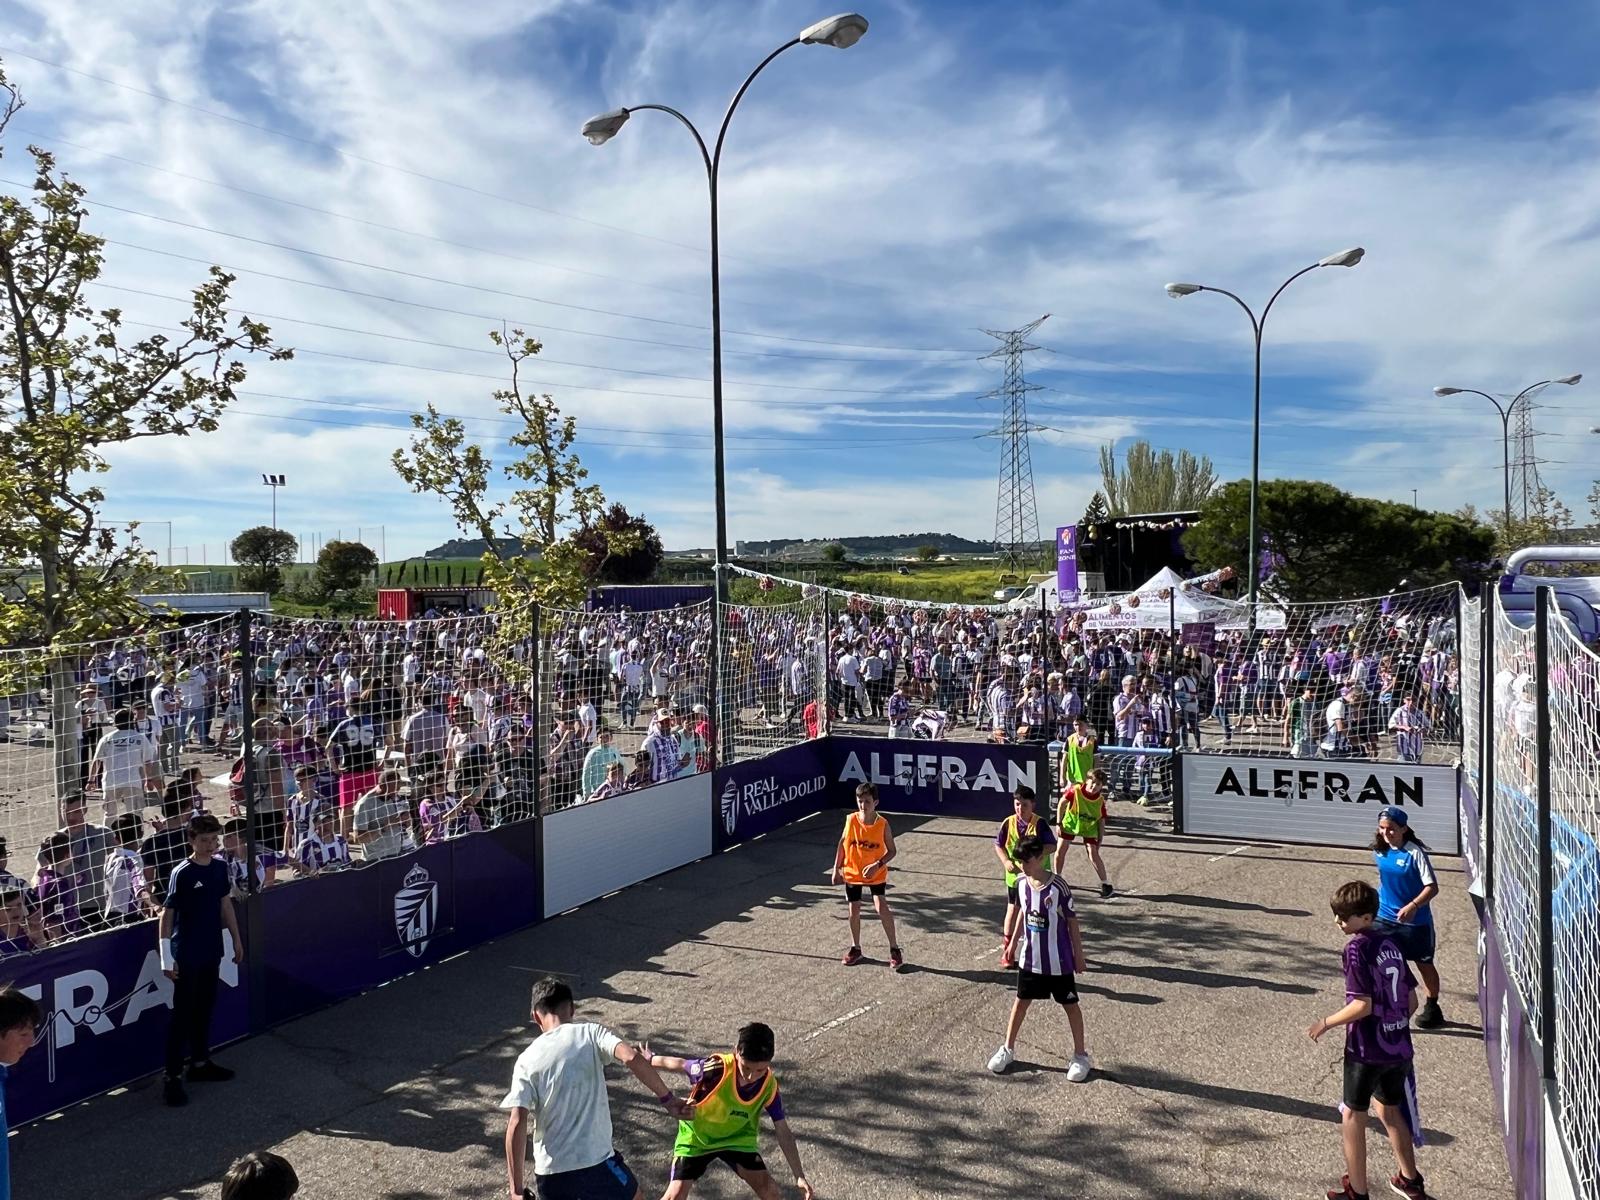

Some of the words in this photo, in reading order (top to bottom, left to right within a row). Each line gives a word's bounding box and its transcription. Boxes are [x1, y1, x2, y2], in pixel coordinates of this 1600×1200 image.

[743, 776, 778, 803] REAL
[838, 751, 1037, 794] ALEFRAN
[1215, 767, 1423, 807] ALEFRAN
[744, 775, 826, 816] VALLADOLID
[1386, 966, 1399, 1002] 7
